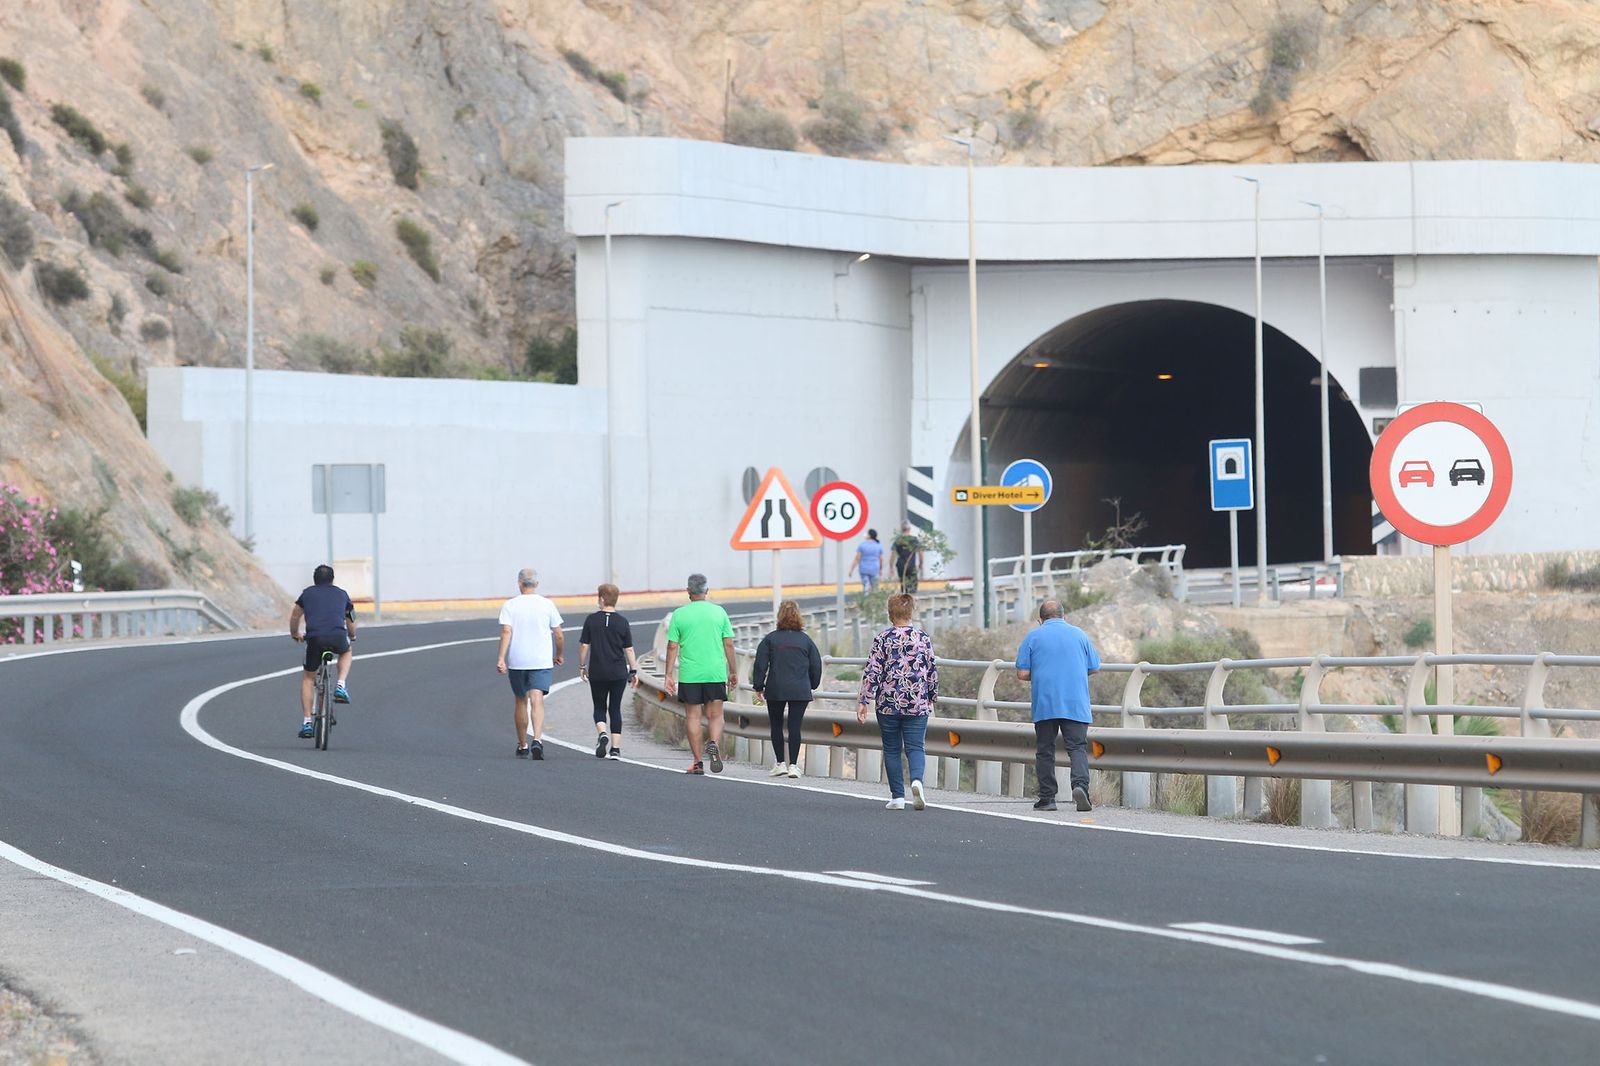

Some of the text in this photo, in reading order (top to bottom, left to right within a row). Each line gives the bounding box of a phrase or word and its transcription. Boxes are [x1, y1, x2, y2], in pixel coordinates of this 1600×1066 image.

[973, 490, 1024, 499] Diver Hotel
[824, 502, 855, 520] 60
